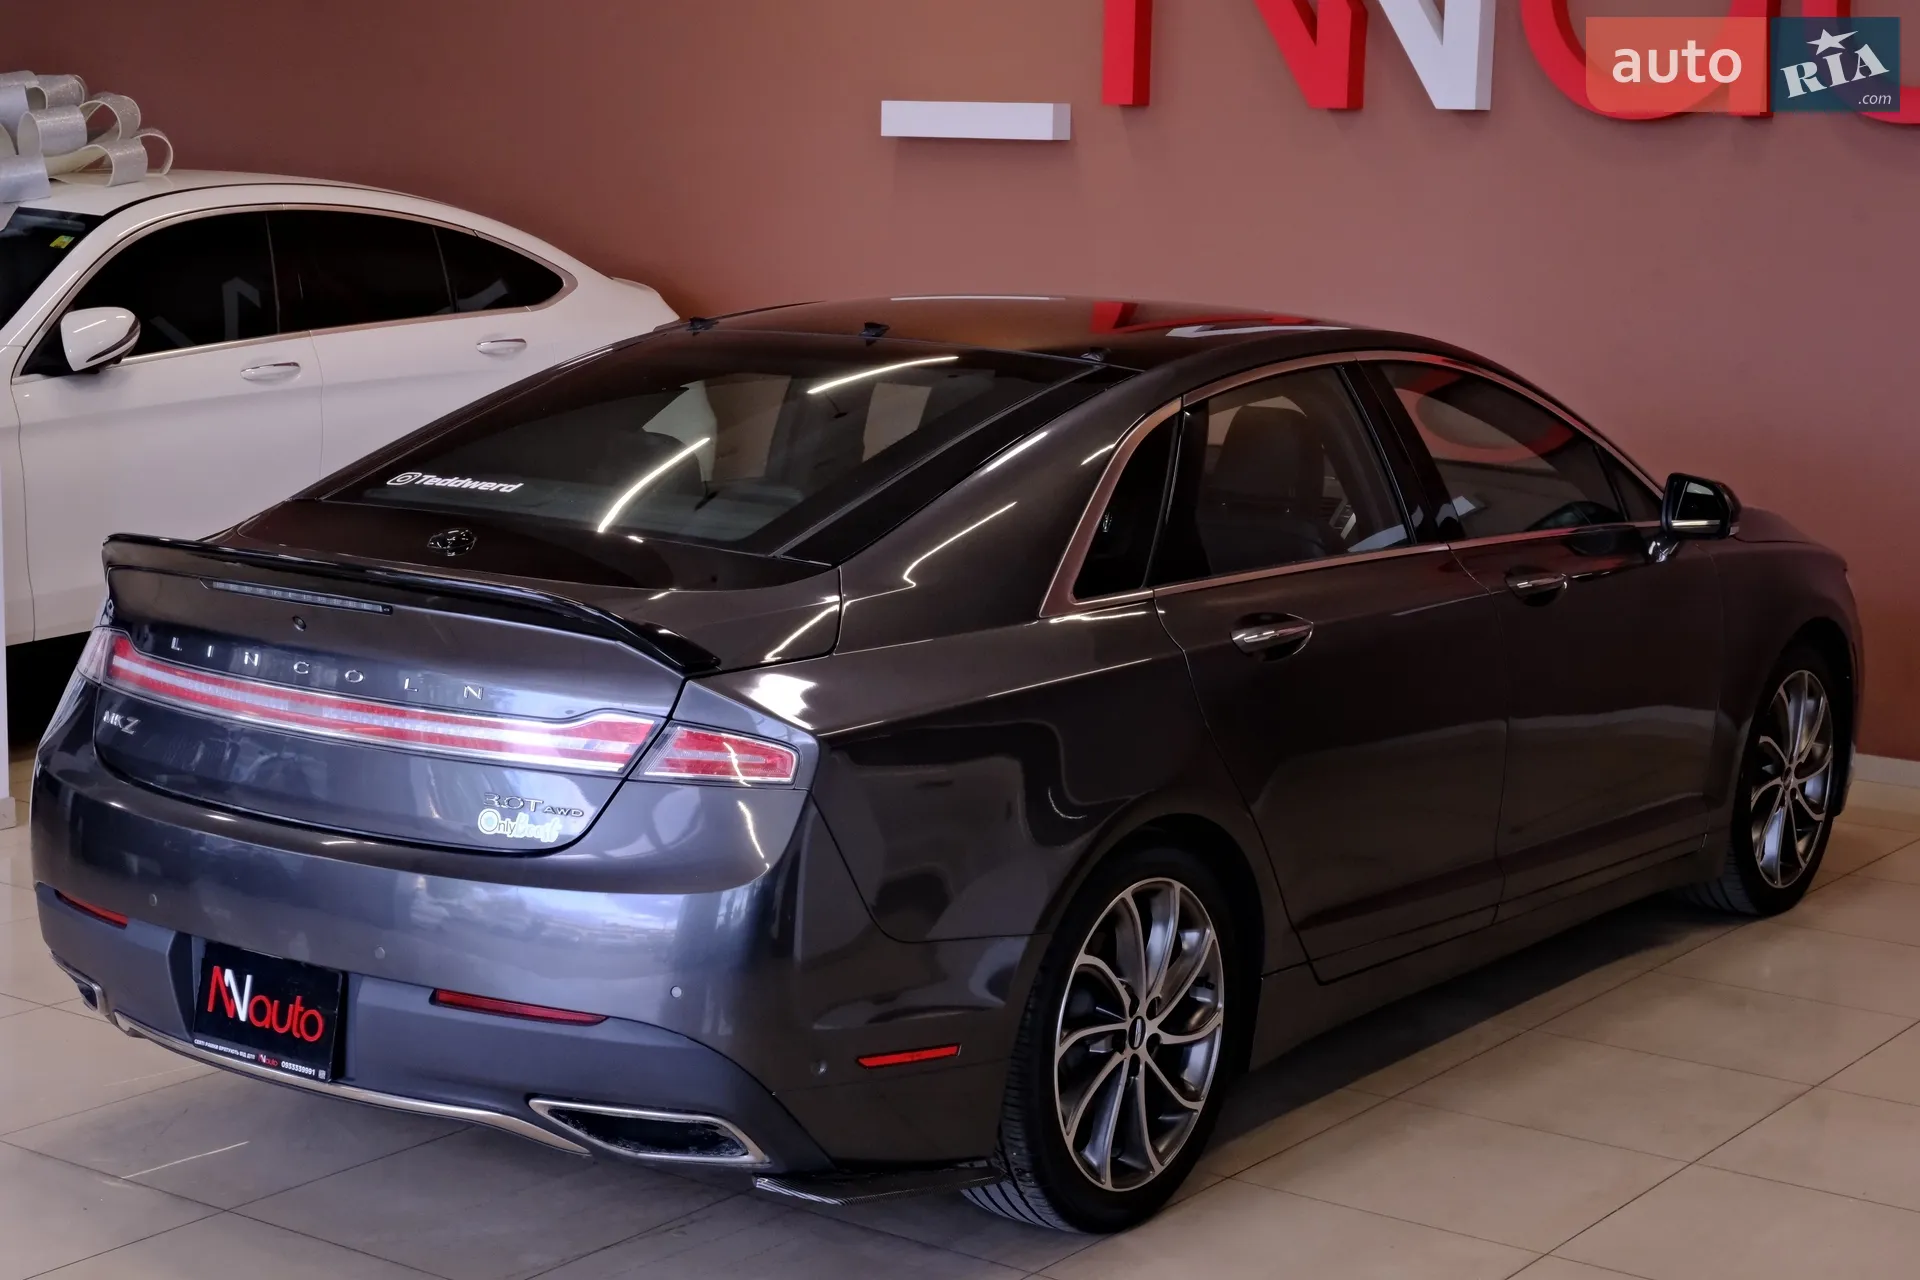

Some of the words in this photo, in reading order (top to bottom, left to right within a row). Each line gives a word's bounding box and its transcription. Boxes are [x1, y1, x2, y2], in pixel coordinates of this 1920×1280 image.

[415, 475, 524, 493] Teddwerd
[170, 636, 484, 701] LINCOLN
[103, 710, 141, 735] MKZ
[543, 806, 585, 818] AWD
